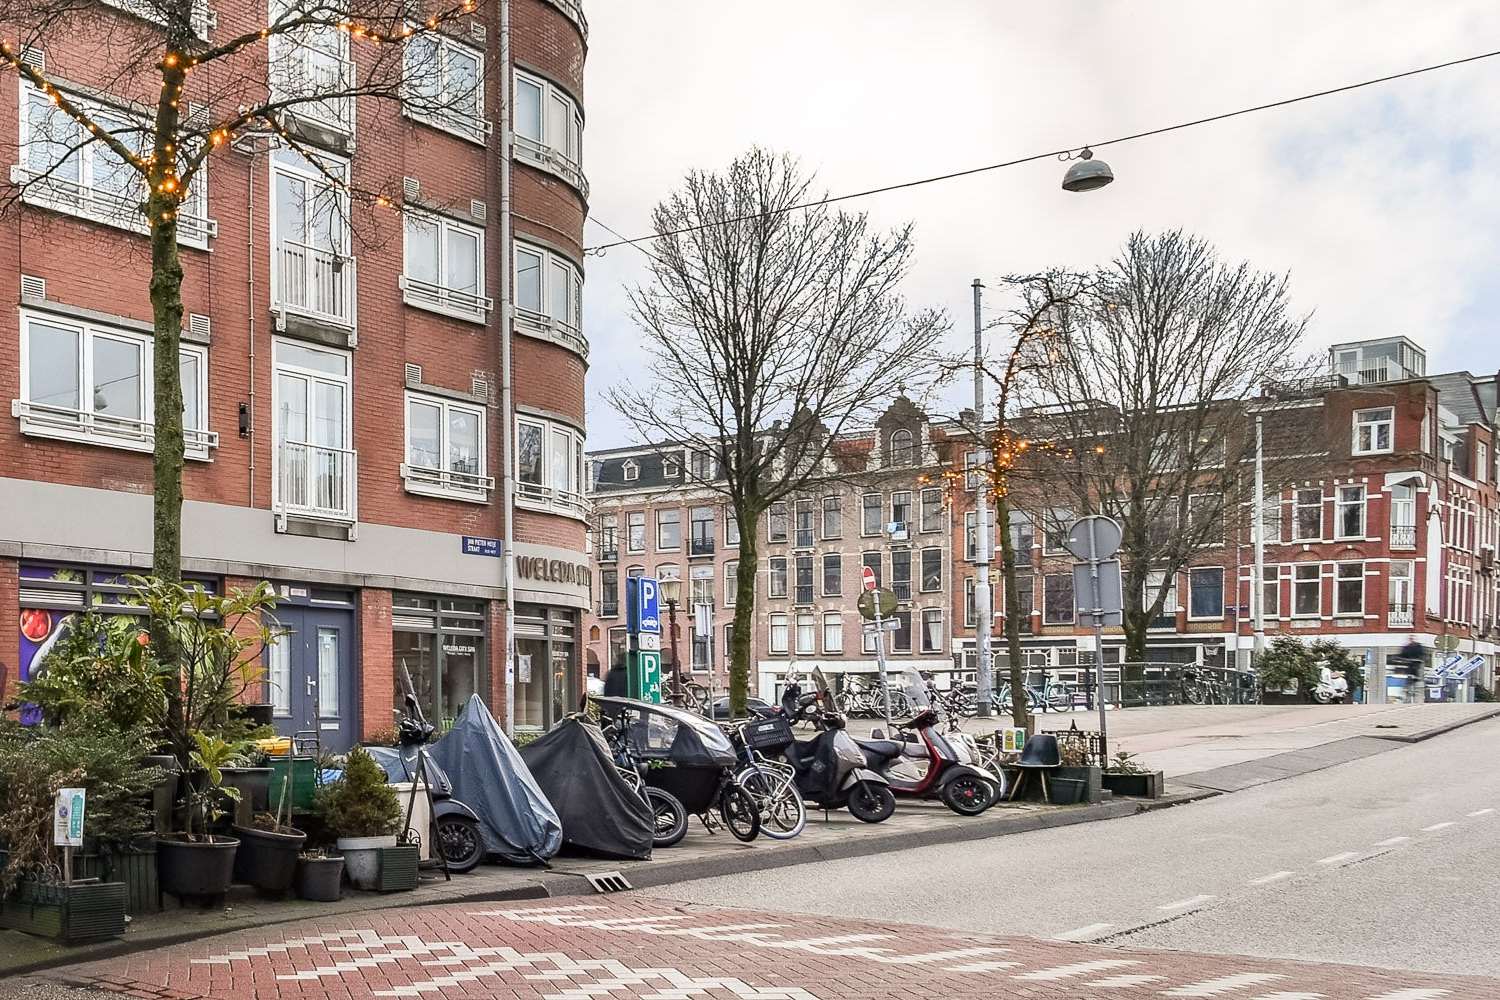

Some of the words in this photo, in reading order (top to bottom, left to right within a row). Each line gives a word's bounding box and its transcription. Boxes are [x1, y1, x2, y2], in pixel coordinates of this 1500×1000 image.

[516, 555, 575, 584] WELEDA
[643, 582, 655, 609] P
[644, 655, 657, 683] P
